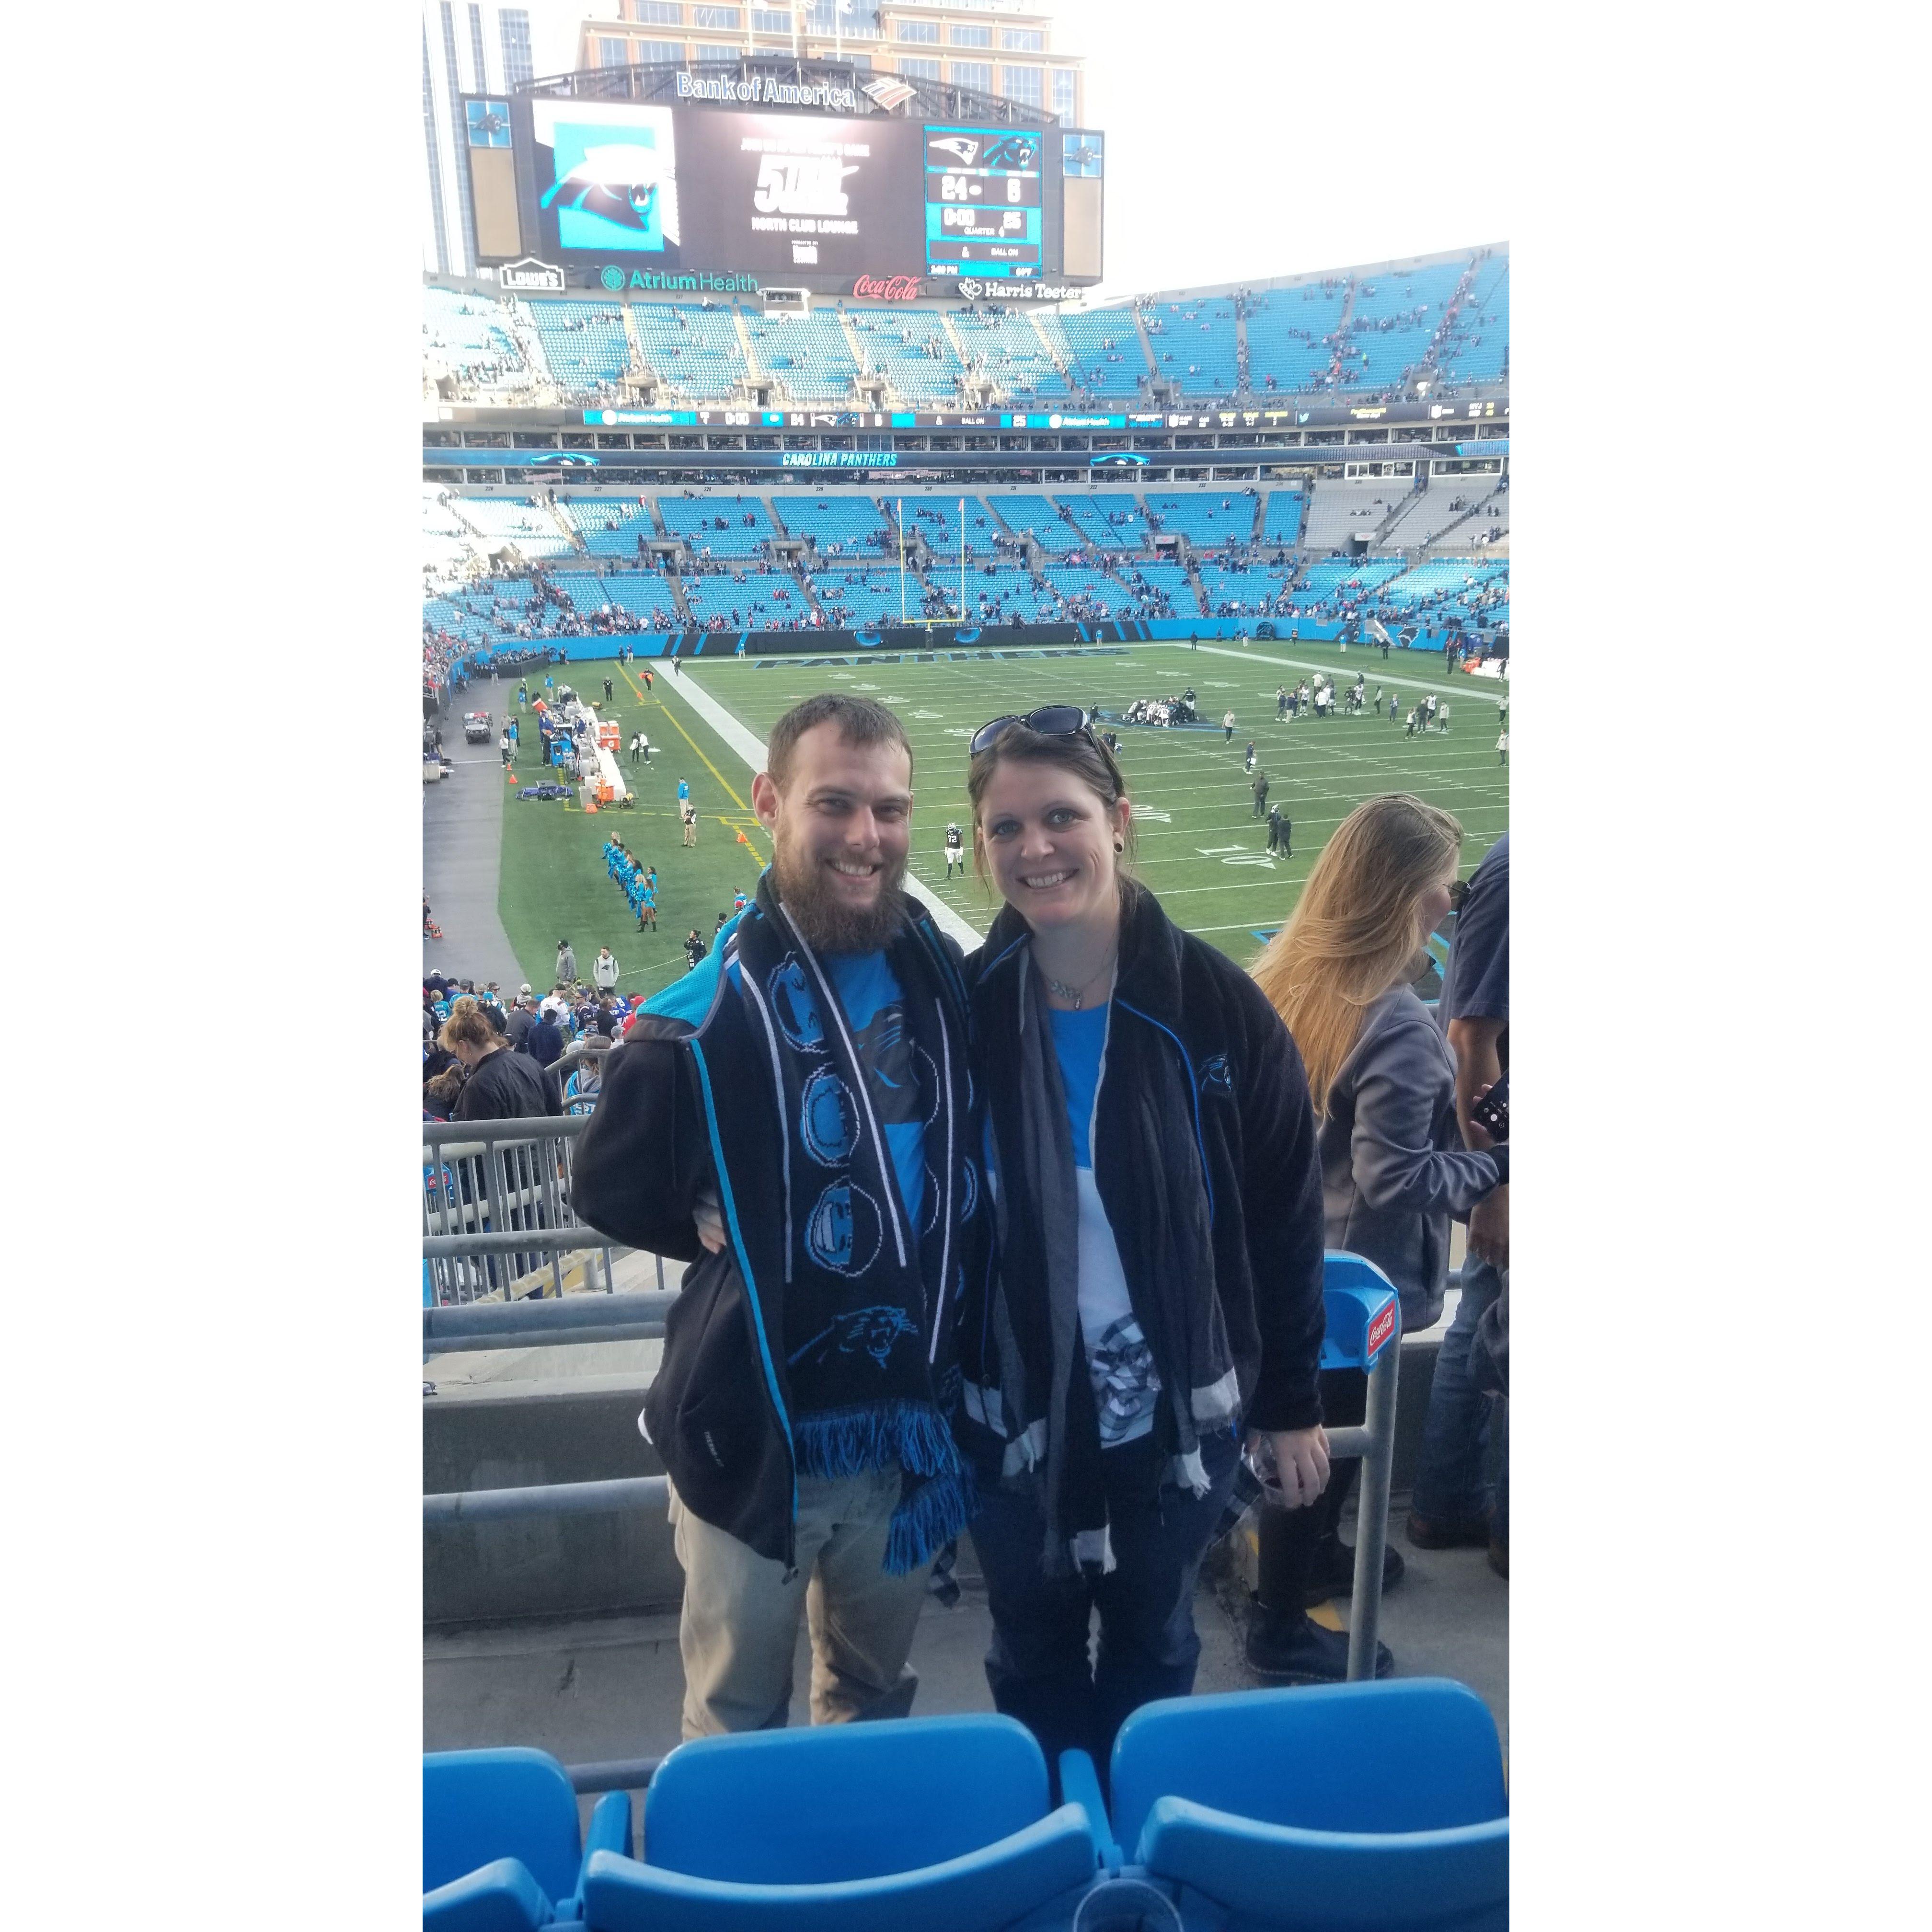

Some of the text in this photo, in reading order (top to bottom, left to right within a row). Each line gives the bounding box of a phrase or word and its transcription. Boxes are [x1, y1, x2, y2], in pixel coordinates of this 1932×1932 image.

[677, 72, 855, 107] Bank of America
[942, 175, 967, 200] 24
[751, 217, 858, 234] NORTH CLUB LOUNGE
[944, 208, 975, 226] 0:00
[964, 227, 995, 236] QUARTER
[630, 270, 759, 292] Atrium Health
[853, 275, 921, 300] Coca-Cola
[985, 282, 1082, 299] Harris Teeter
[725, 412, 749, 425] 0:00
[791, 414, 804, 426] 24
[1013, 414, 1026, 427] 25
[782, 453, 897, 467] CAROLINA PANTHERS
[1369, 1309, 1393, 1346] Coca-Cola
